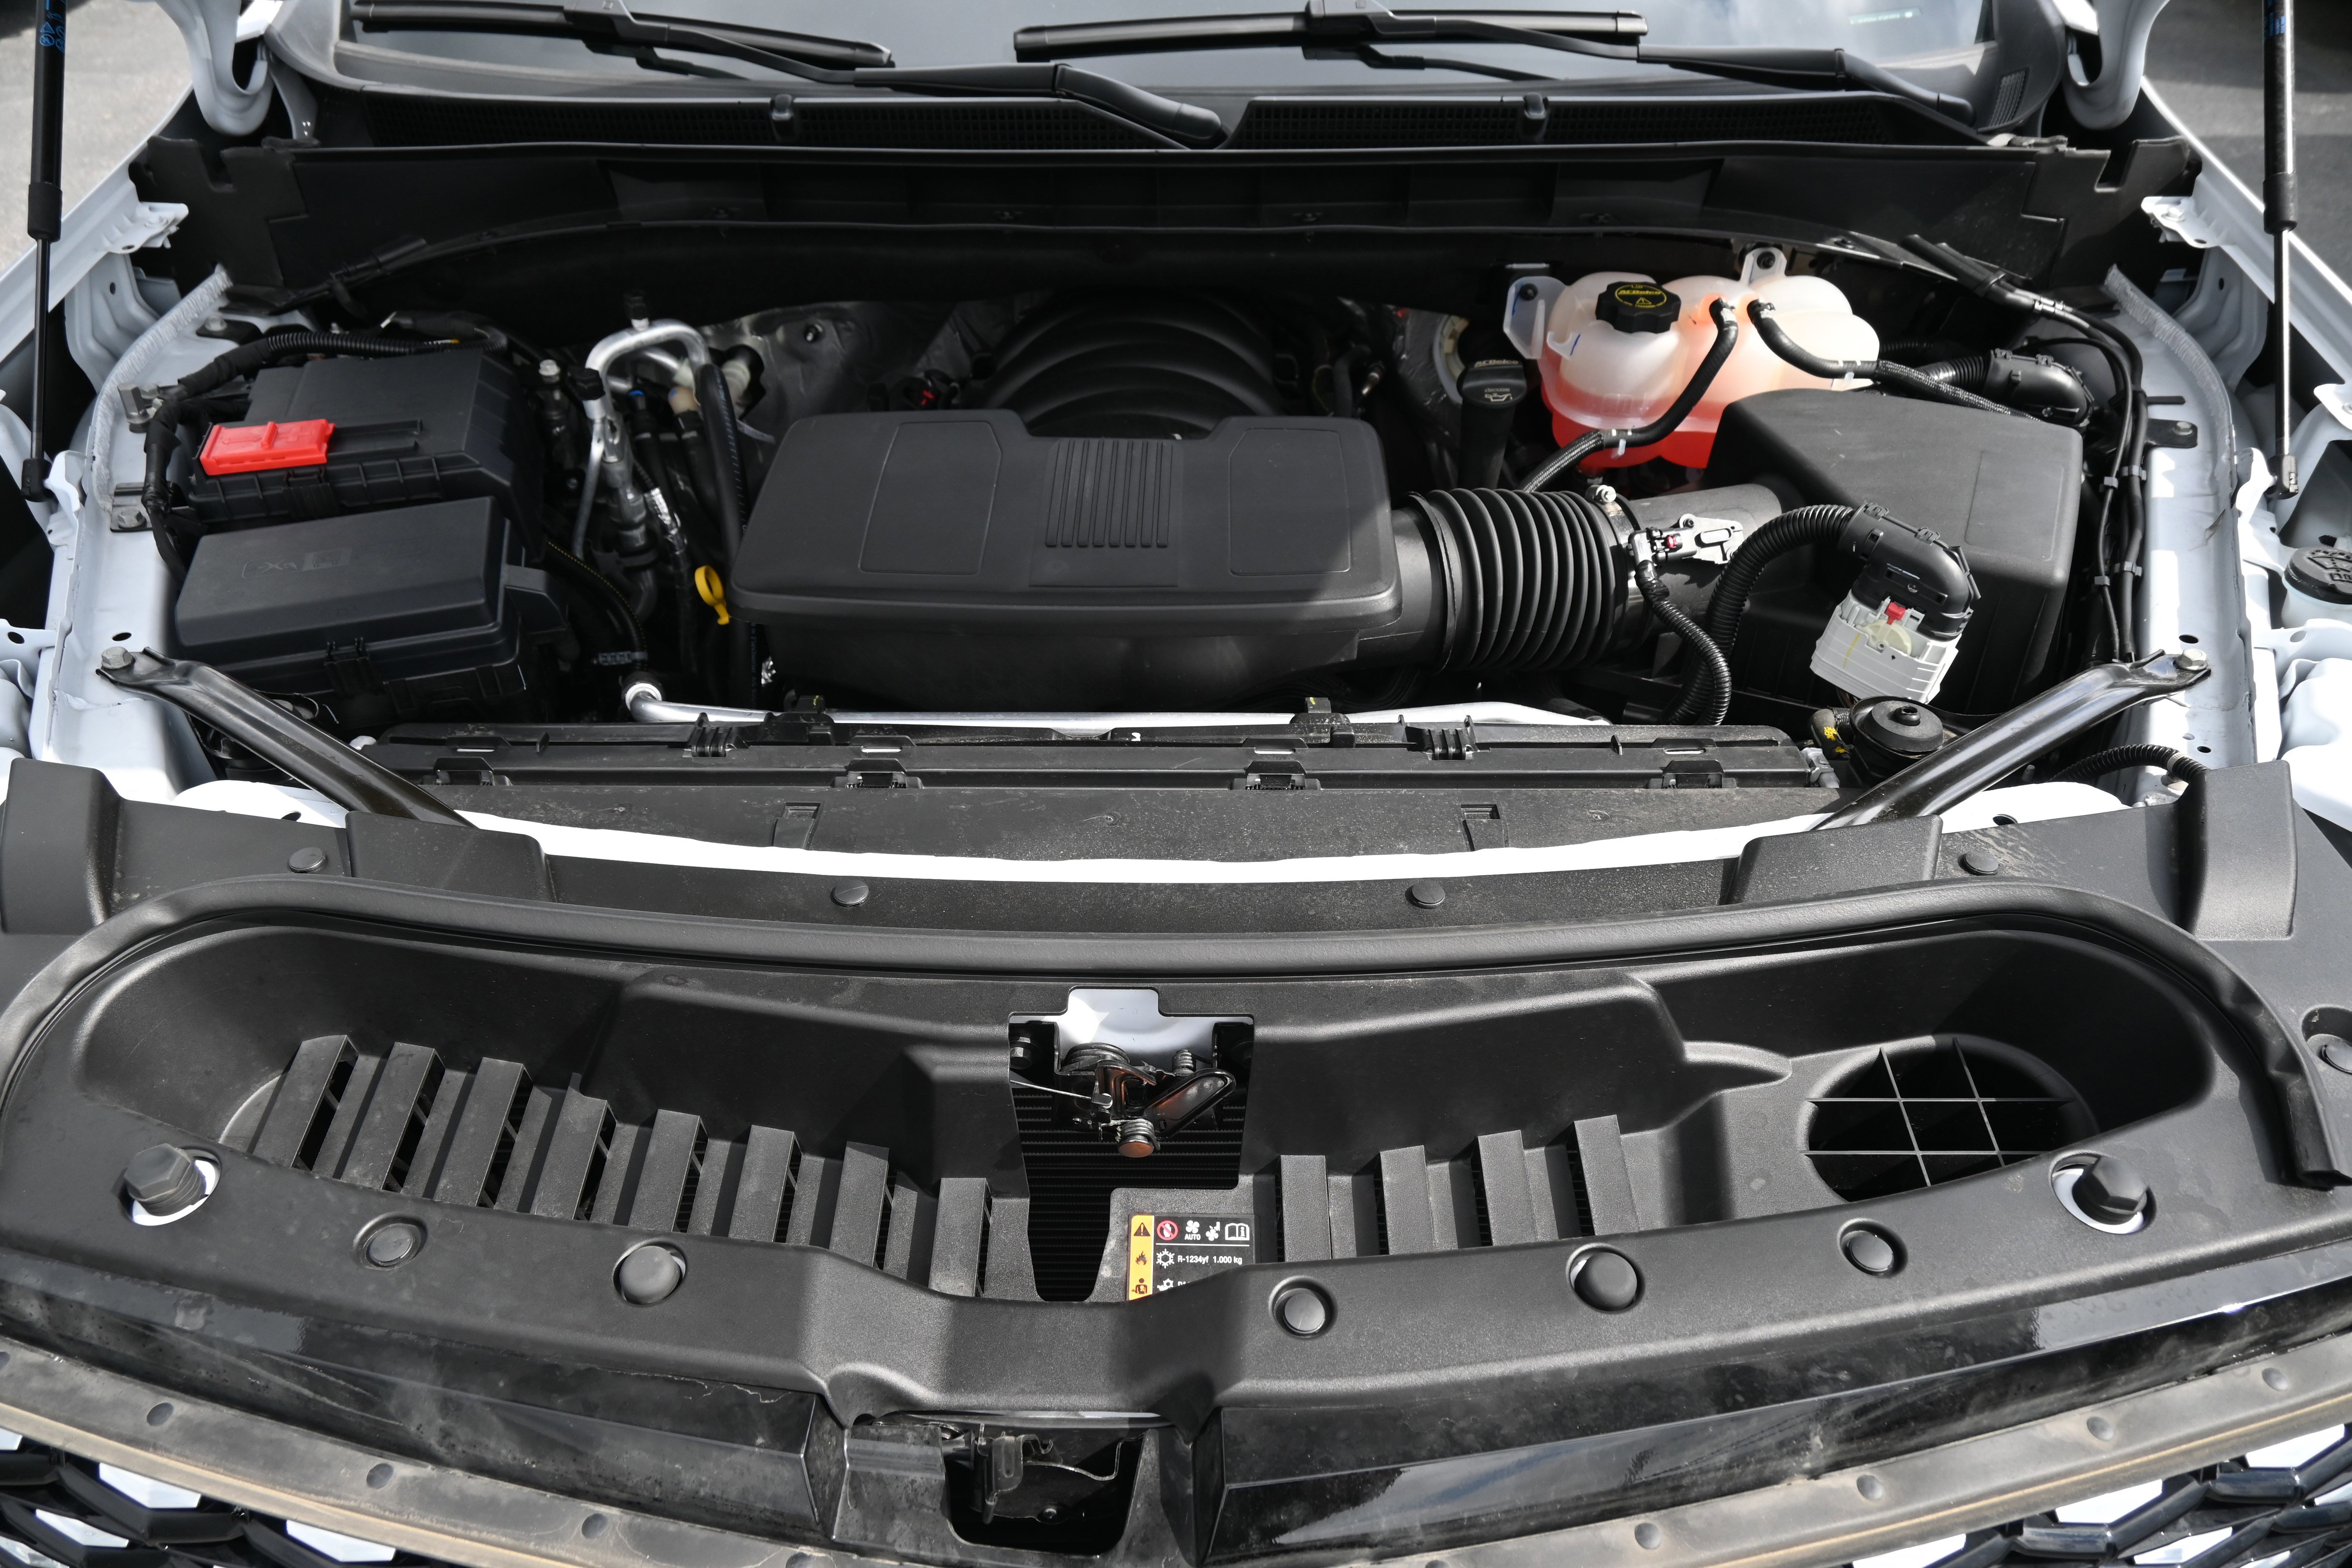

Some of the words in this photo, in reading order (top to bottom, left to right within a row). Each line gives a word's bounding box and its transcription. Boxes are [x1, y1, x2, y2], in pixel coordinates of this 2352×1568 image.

[1474, 359, 1519, 368] ACDelco
[1178, 1255, 1209, 1264] R-1234yf
[1234, 1256, 1242, 1265] kg
